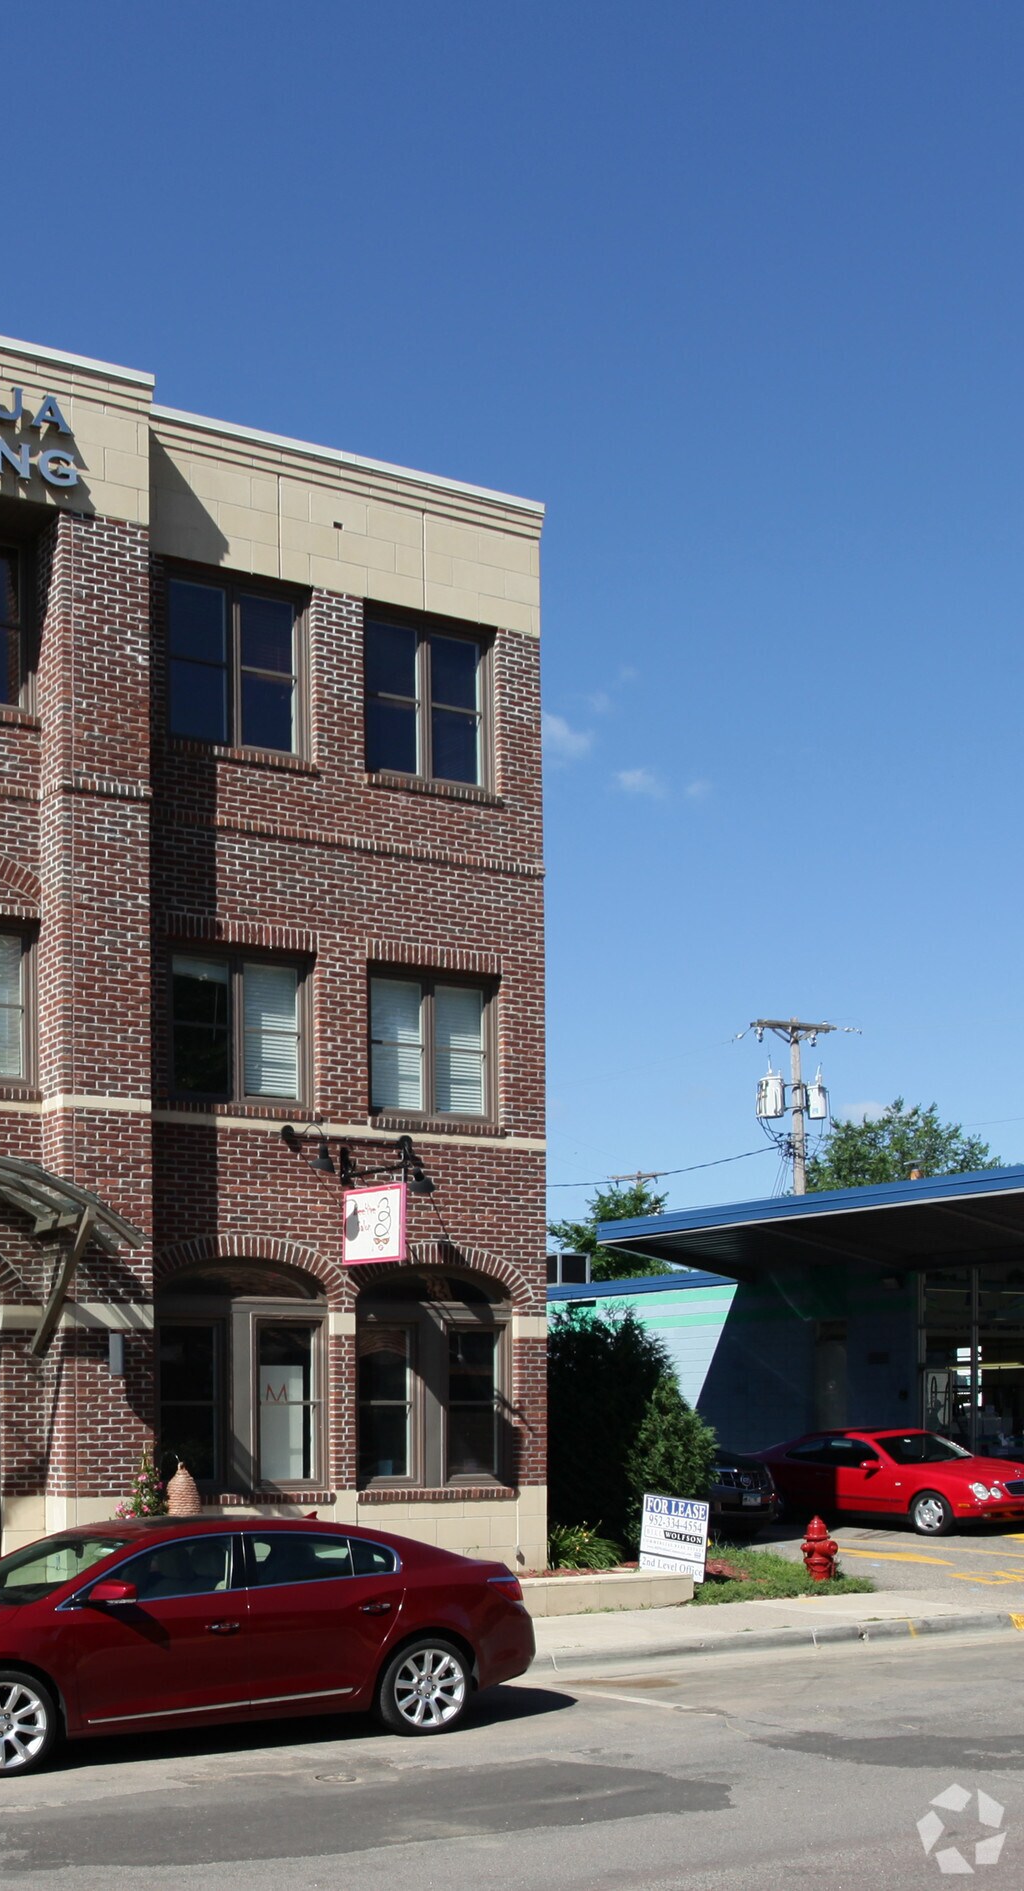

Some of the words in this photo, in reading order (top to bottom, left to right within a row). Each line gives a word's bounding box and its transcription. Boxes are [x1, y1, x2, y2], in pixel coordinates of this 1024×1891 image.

[646, 1497, 669, 1514] FOR
[671, 1501, 706, 1519] LEASE
[648, 1514, 703, 1533] 952-334-4554
[665, 1531, 702, 1544] WOLFSON
[642, 1556, 656, 1567] 2nd
[657, 1560, 677, 1572] Level
[679, 1563, 703, 1577] Office
